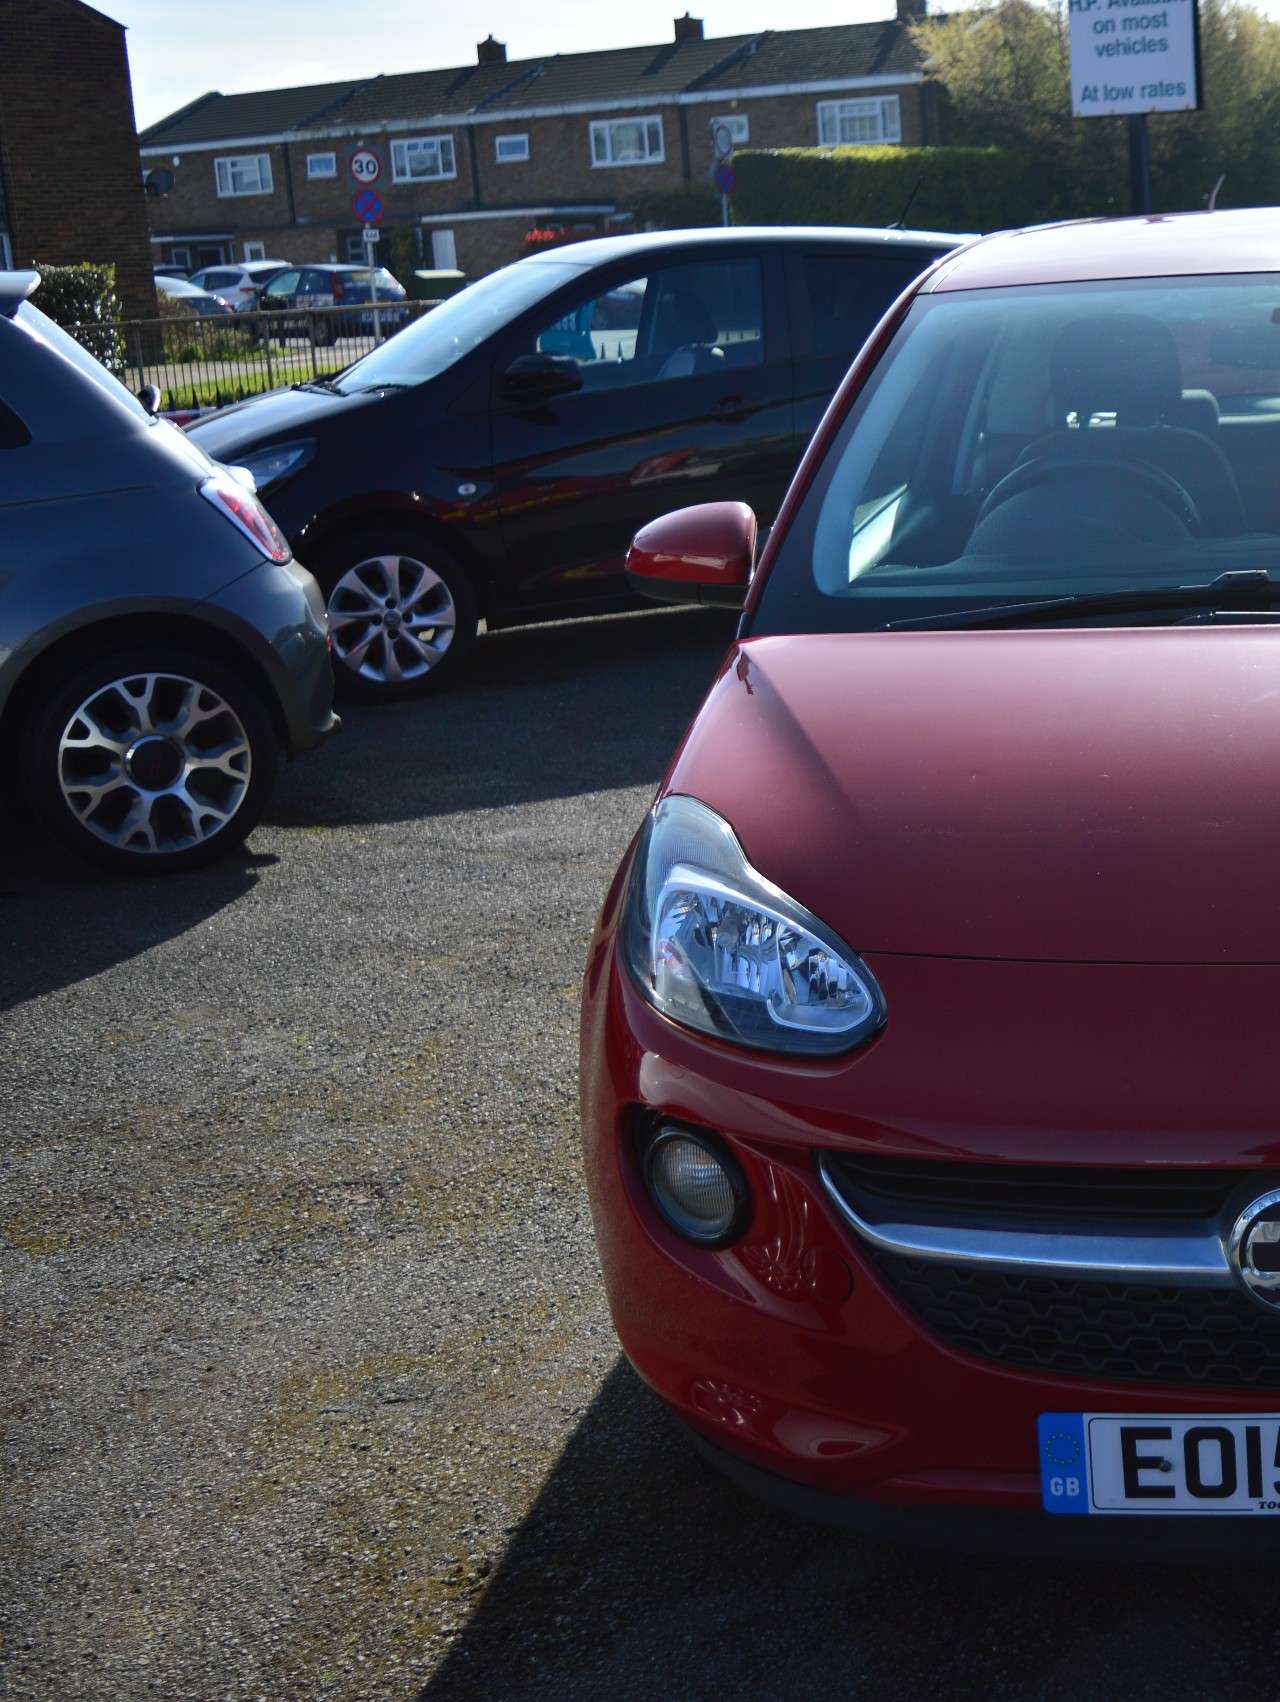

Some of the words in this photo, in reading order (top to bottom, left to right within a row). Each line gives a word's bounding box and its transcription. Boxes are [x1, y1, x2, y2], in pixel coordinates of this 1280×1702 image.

[1093, 18, 1115, 34] on
[1122, 11, 1168, 31] most
[1095, 36, 1168, 57] vehicles
[1081, 84, 1099, 103] At
[1104, 84, 1134, 101] low
[1141, 80, 1186, 98] rates
[354, 159, 377, 175] 30
[1050, 1476, 1080, 1497] GB
